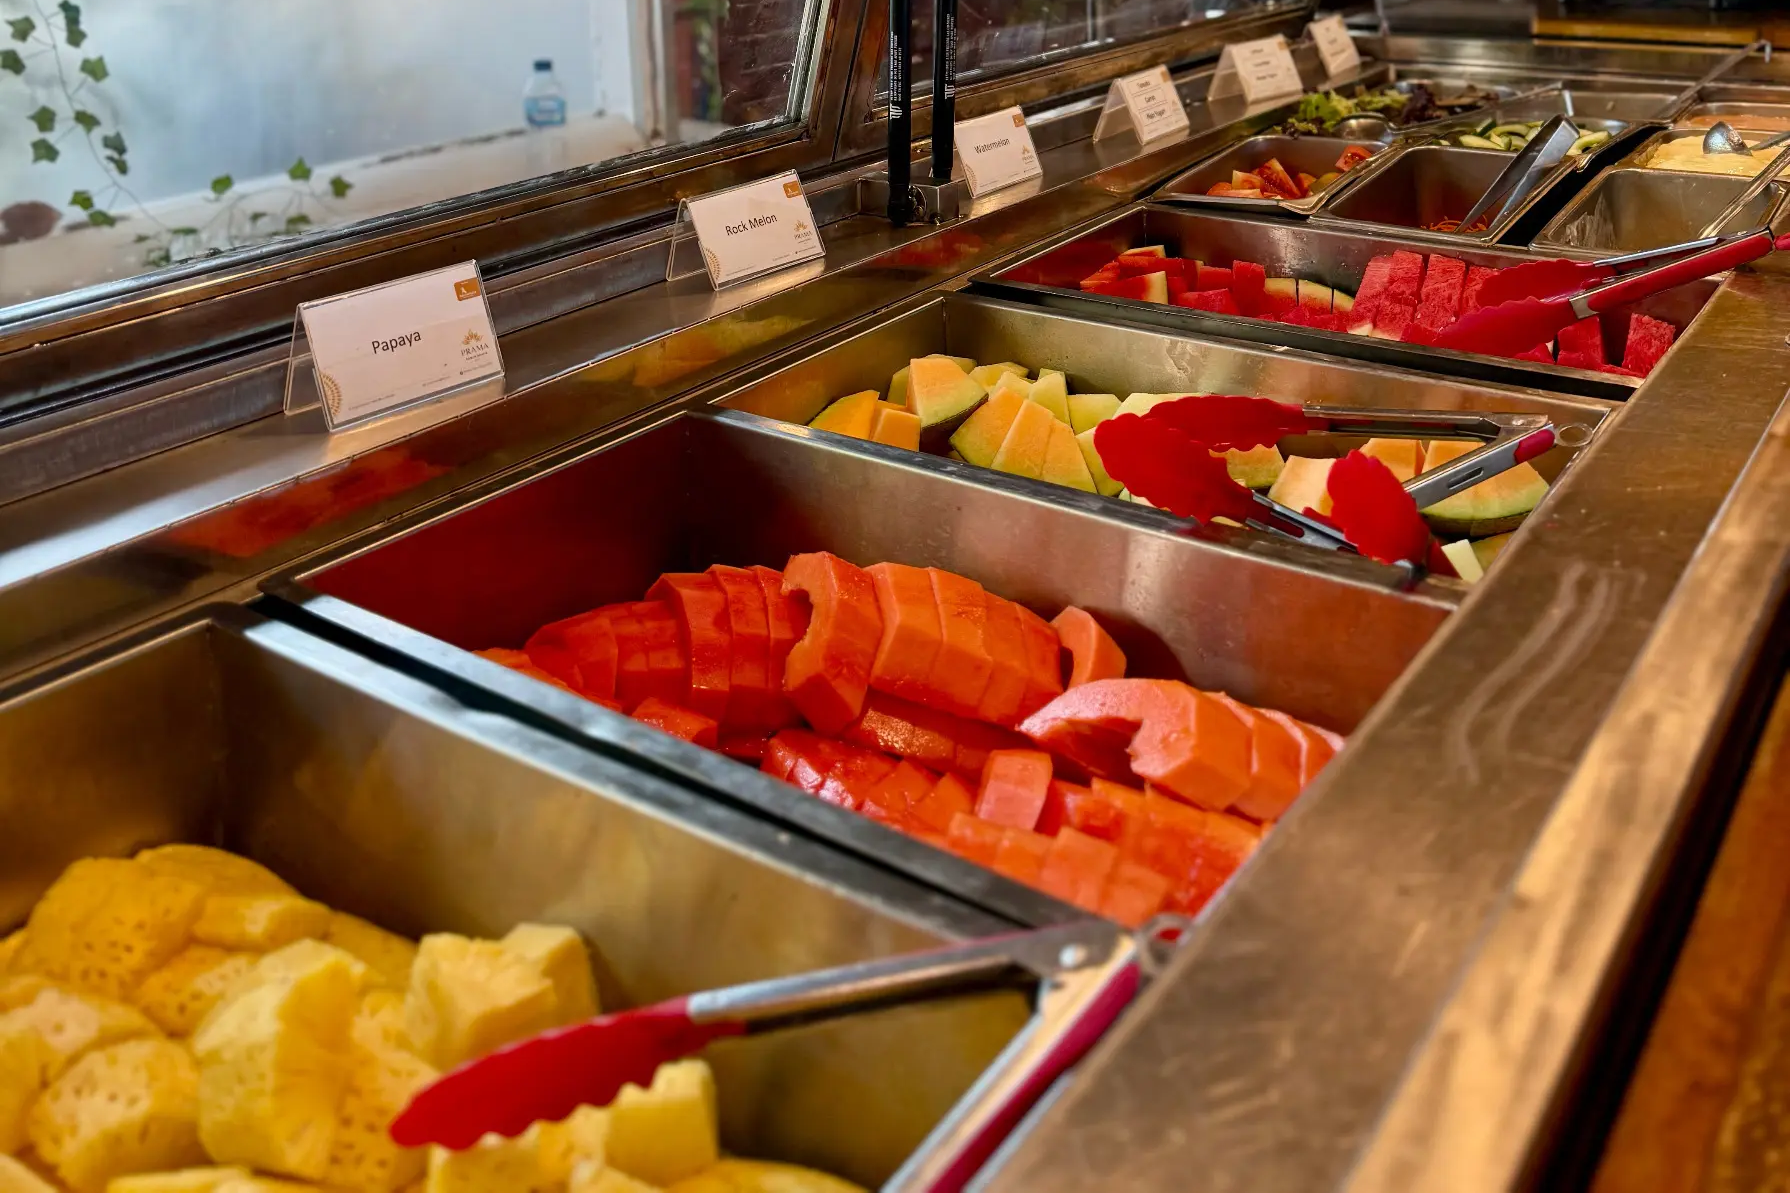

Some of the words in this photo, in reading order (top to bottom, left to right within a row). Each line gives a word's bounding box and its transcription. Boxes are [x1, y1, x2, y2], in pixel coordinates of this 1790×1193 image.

[973, 138, 1011, 155] Watermelon
[725, 220, 748, 236] Rock
[748, 213, 778, 230] Melon
[371, 329, 422, 355] Papaya
[460, 342, 490, 358] PRAMA
